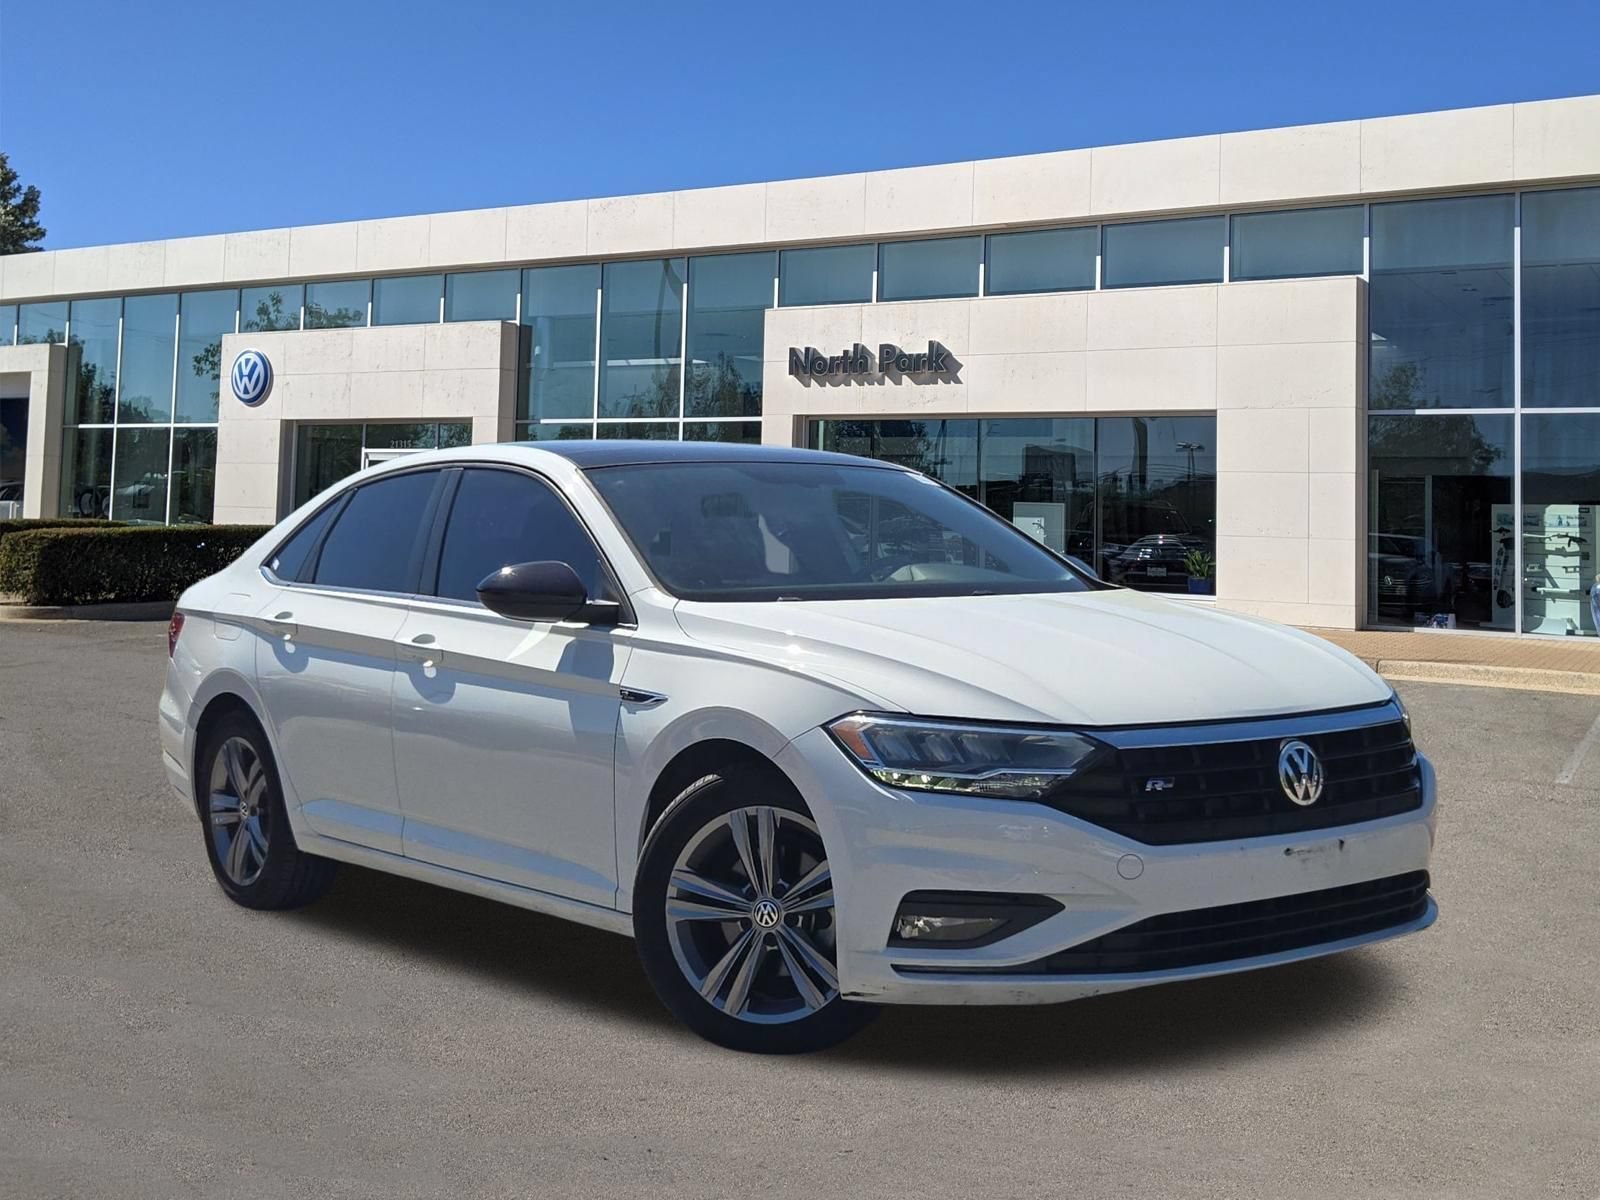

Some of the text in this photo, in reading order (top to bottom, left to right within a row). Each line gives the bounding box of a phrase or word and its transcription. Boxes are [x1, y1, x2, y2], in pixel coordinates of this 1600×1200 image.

[232, 351, 270, 403] VW
[788, 340, 948, 376] North Park
